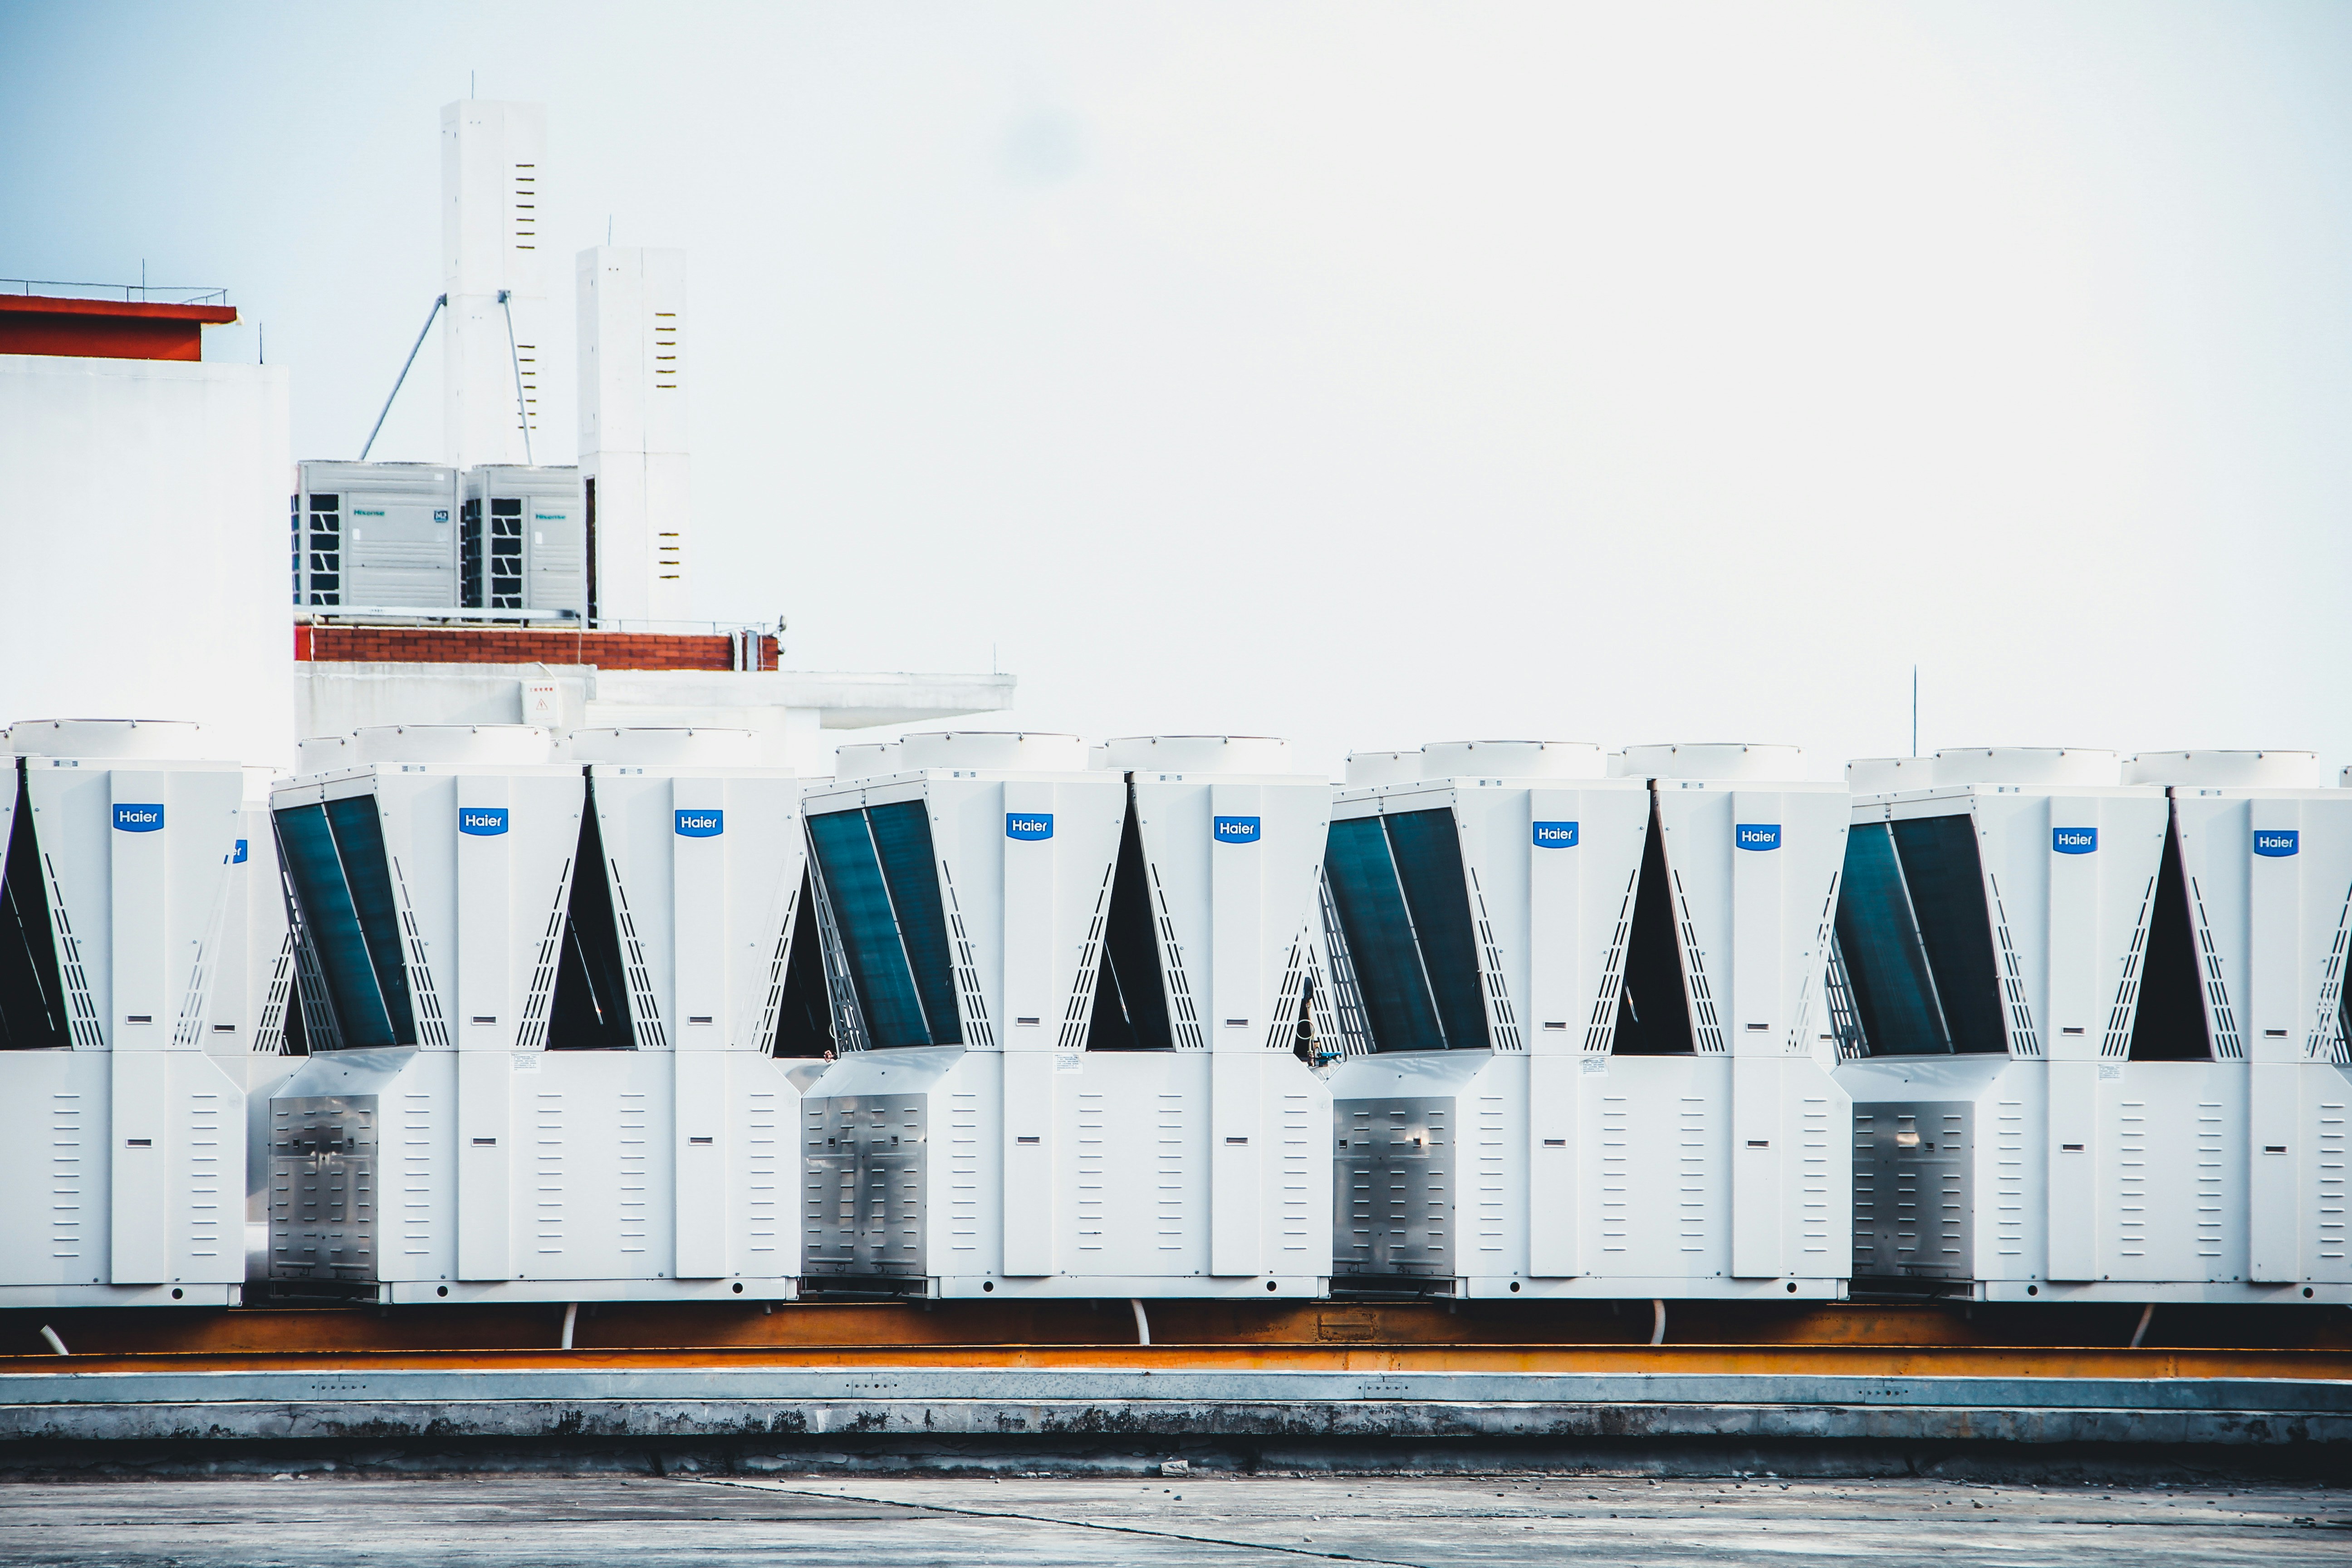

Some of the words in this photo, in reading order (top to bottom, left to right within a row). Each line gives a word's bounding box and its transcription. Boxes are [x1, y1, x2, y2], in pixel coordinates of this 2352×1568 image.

[120, 810, 157, 822] Haier
[466, 814, 502, 826] Haier
[681, 816, 717, 828] Haier
[1013, 819, 1047, 832] Haier
[1220, 822, 1254, 834] Haier
[1539, 828, 1573, 839] Haier
[1742, 830, 1775, 842] Haier
[2059, 833, 2092, 845] Haier
[2259, 837, 2293, 848] Haier
